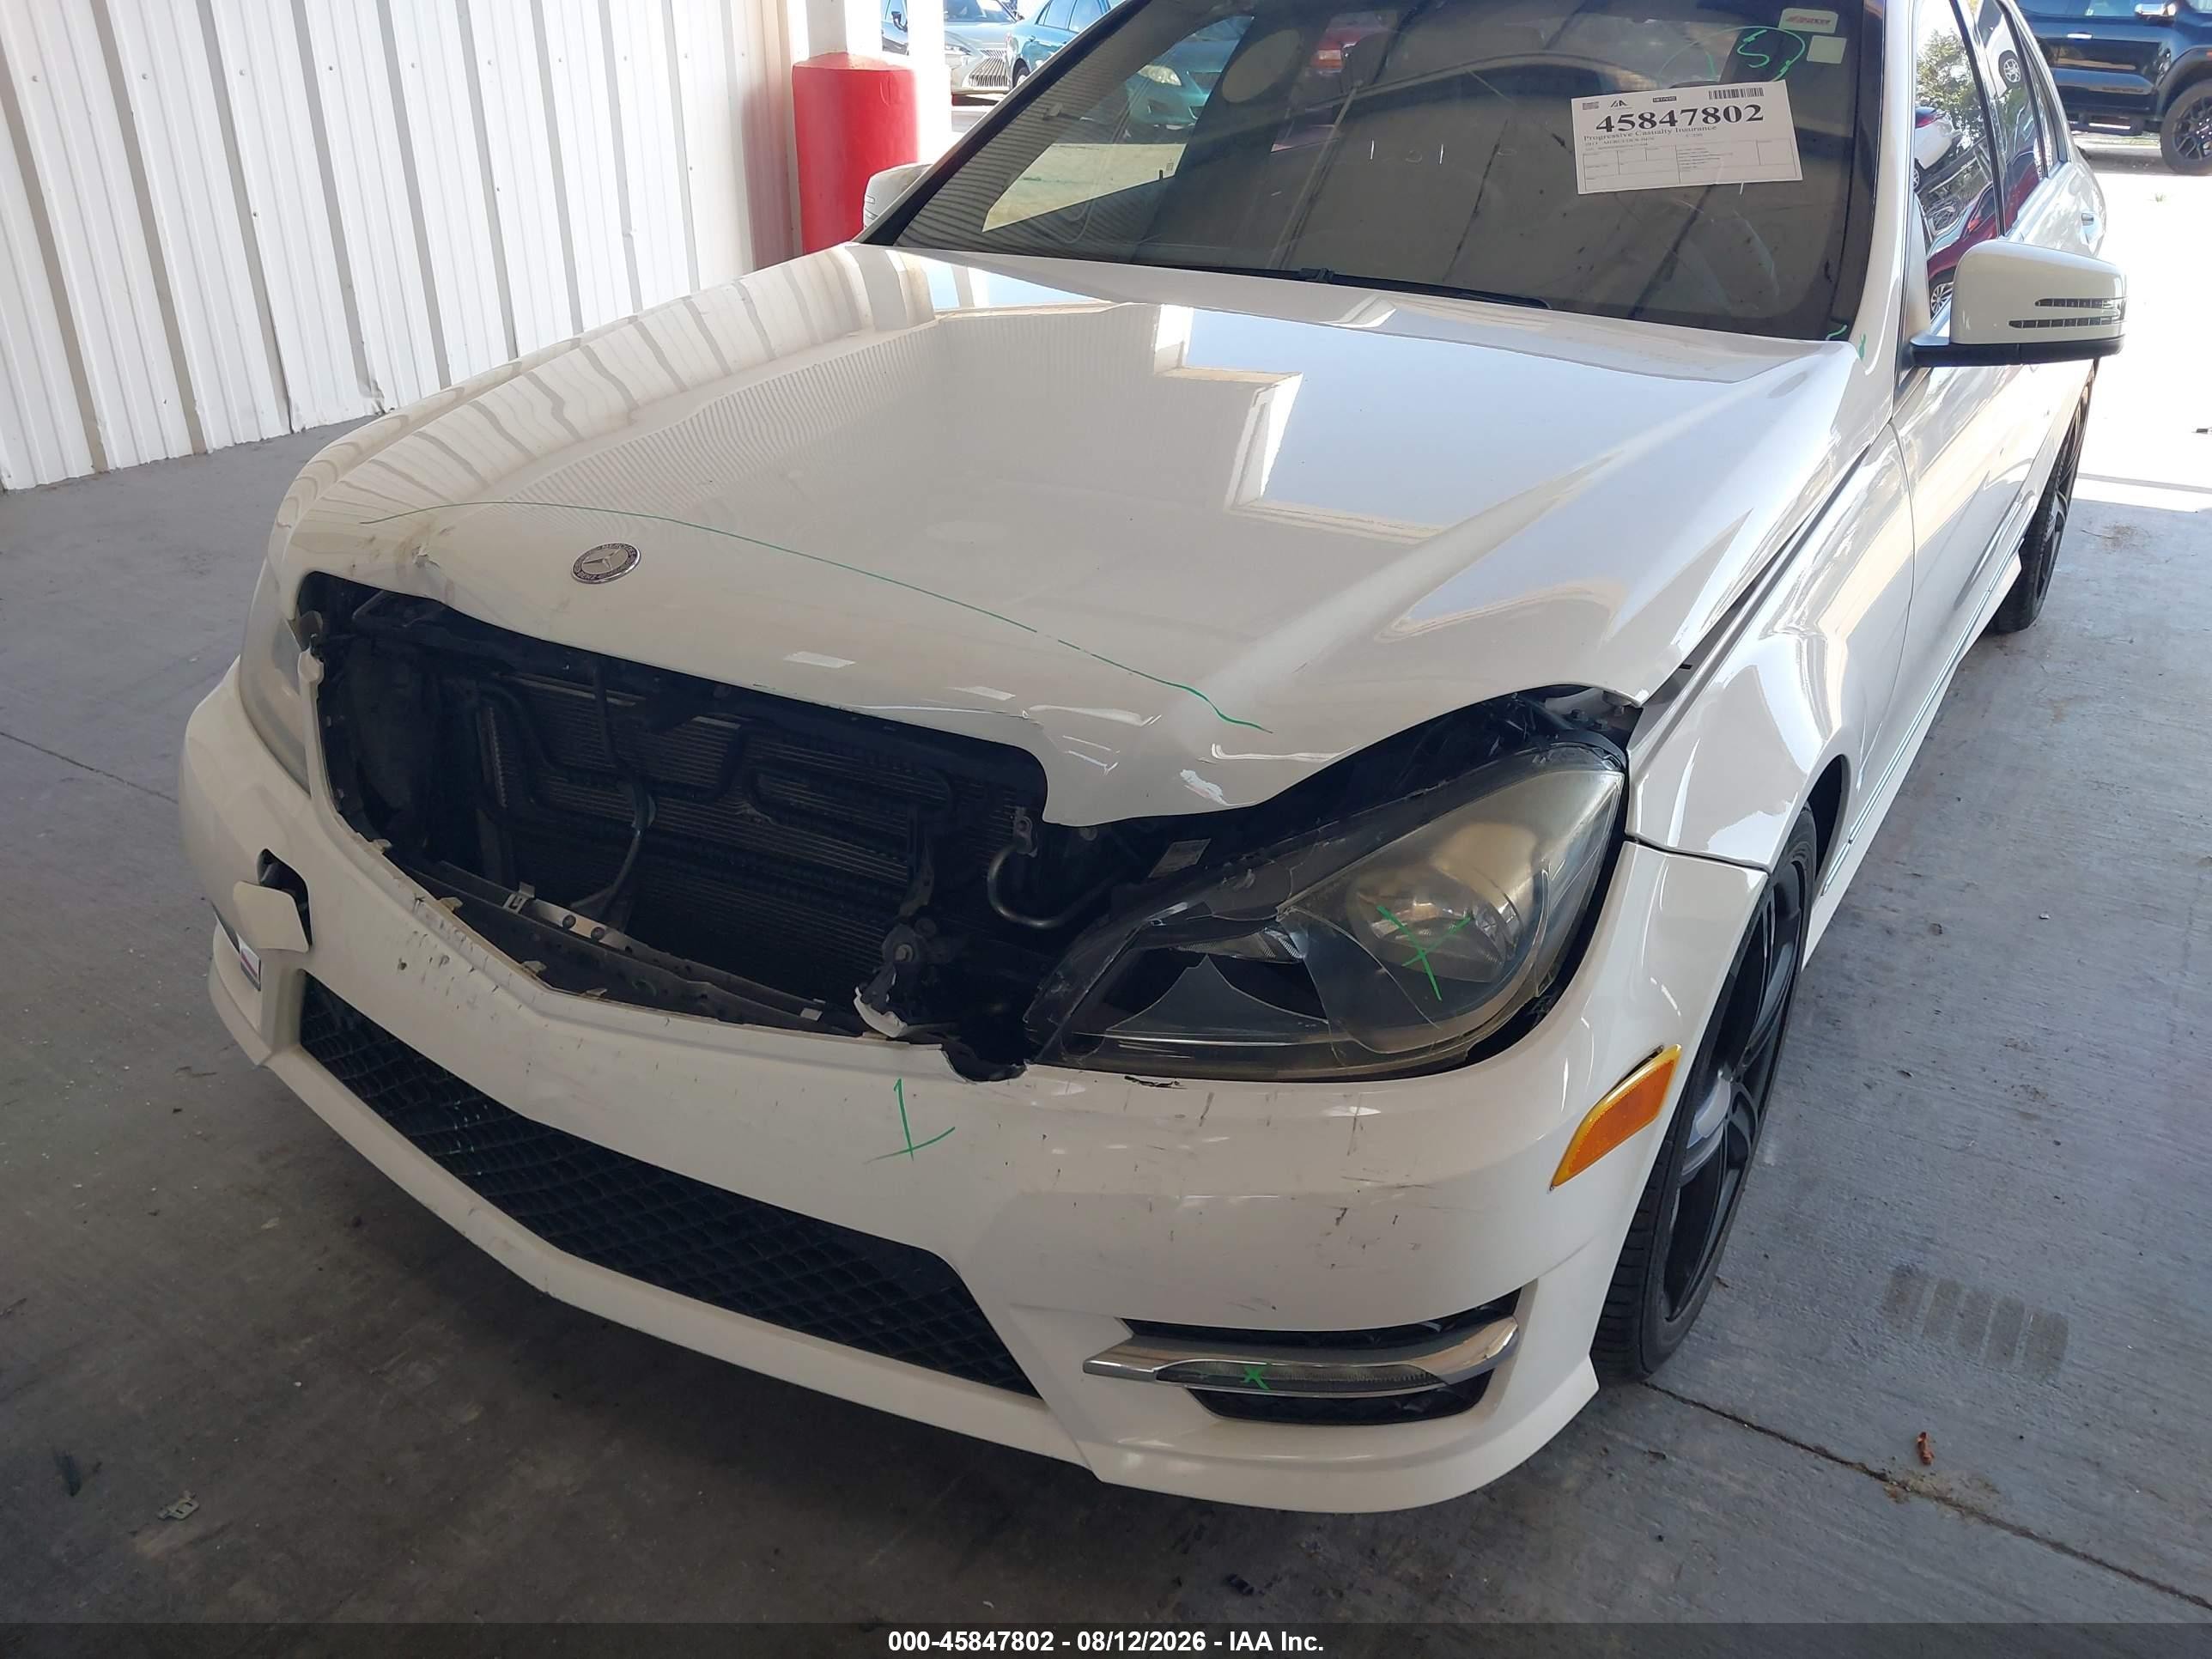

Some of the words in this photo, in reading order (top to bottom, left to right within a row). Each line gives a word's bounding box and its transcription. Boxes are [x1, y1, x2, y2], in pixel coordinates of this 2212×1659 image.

[1595, 104, 1764, 132] 45847802
[1583, 131, 1632, 142] Progressive
[1635, 128, 1673, 137] Casualty
[1674, 125, 1717, 134] Insurance
